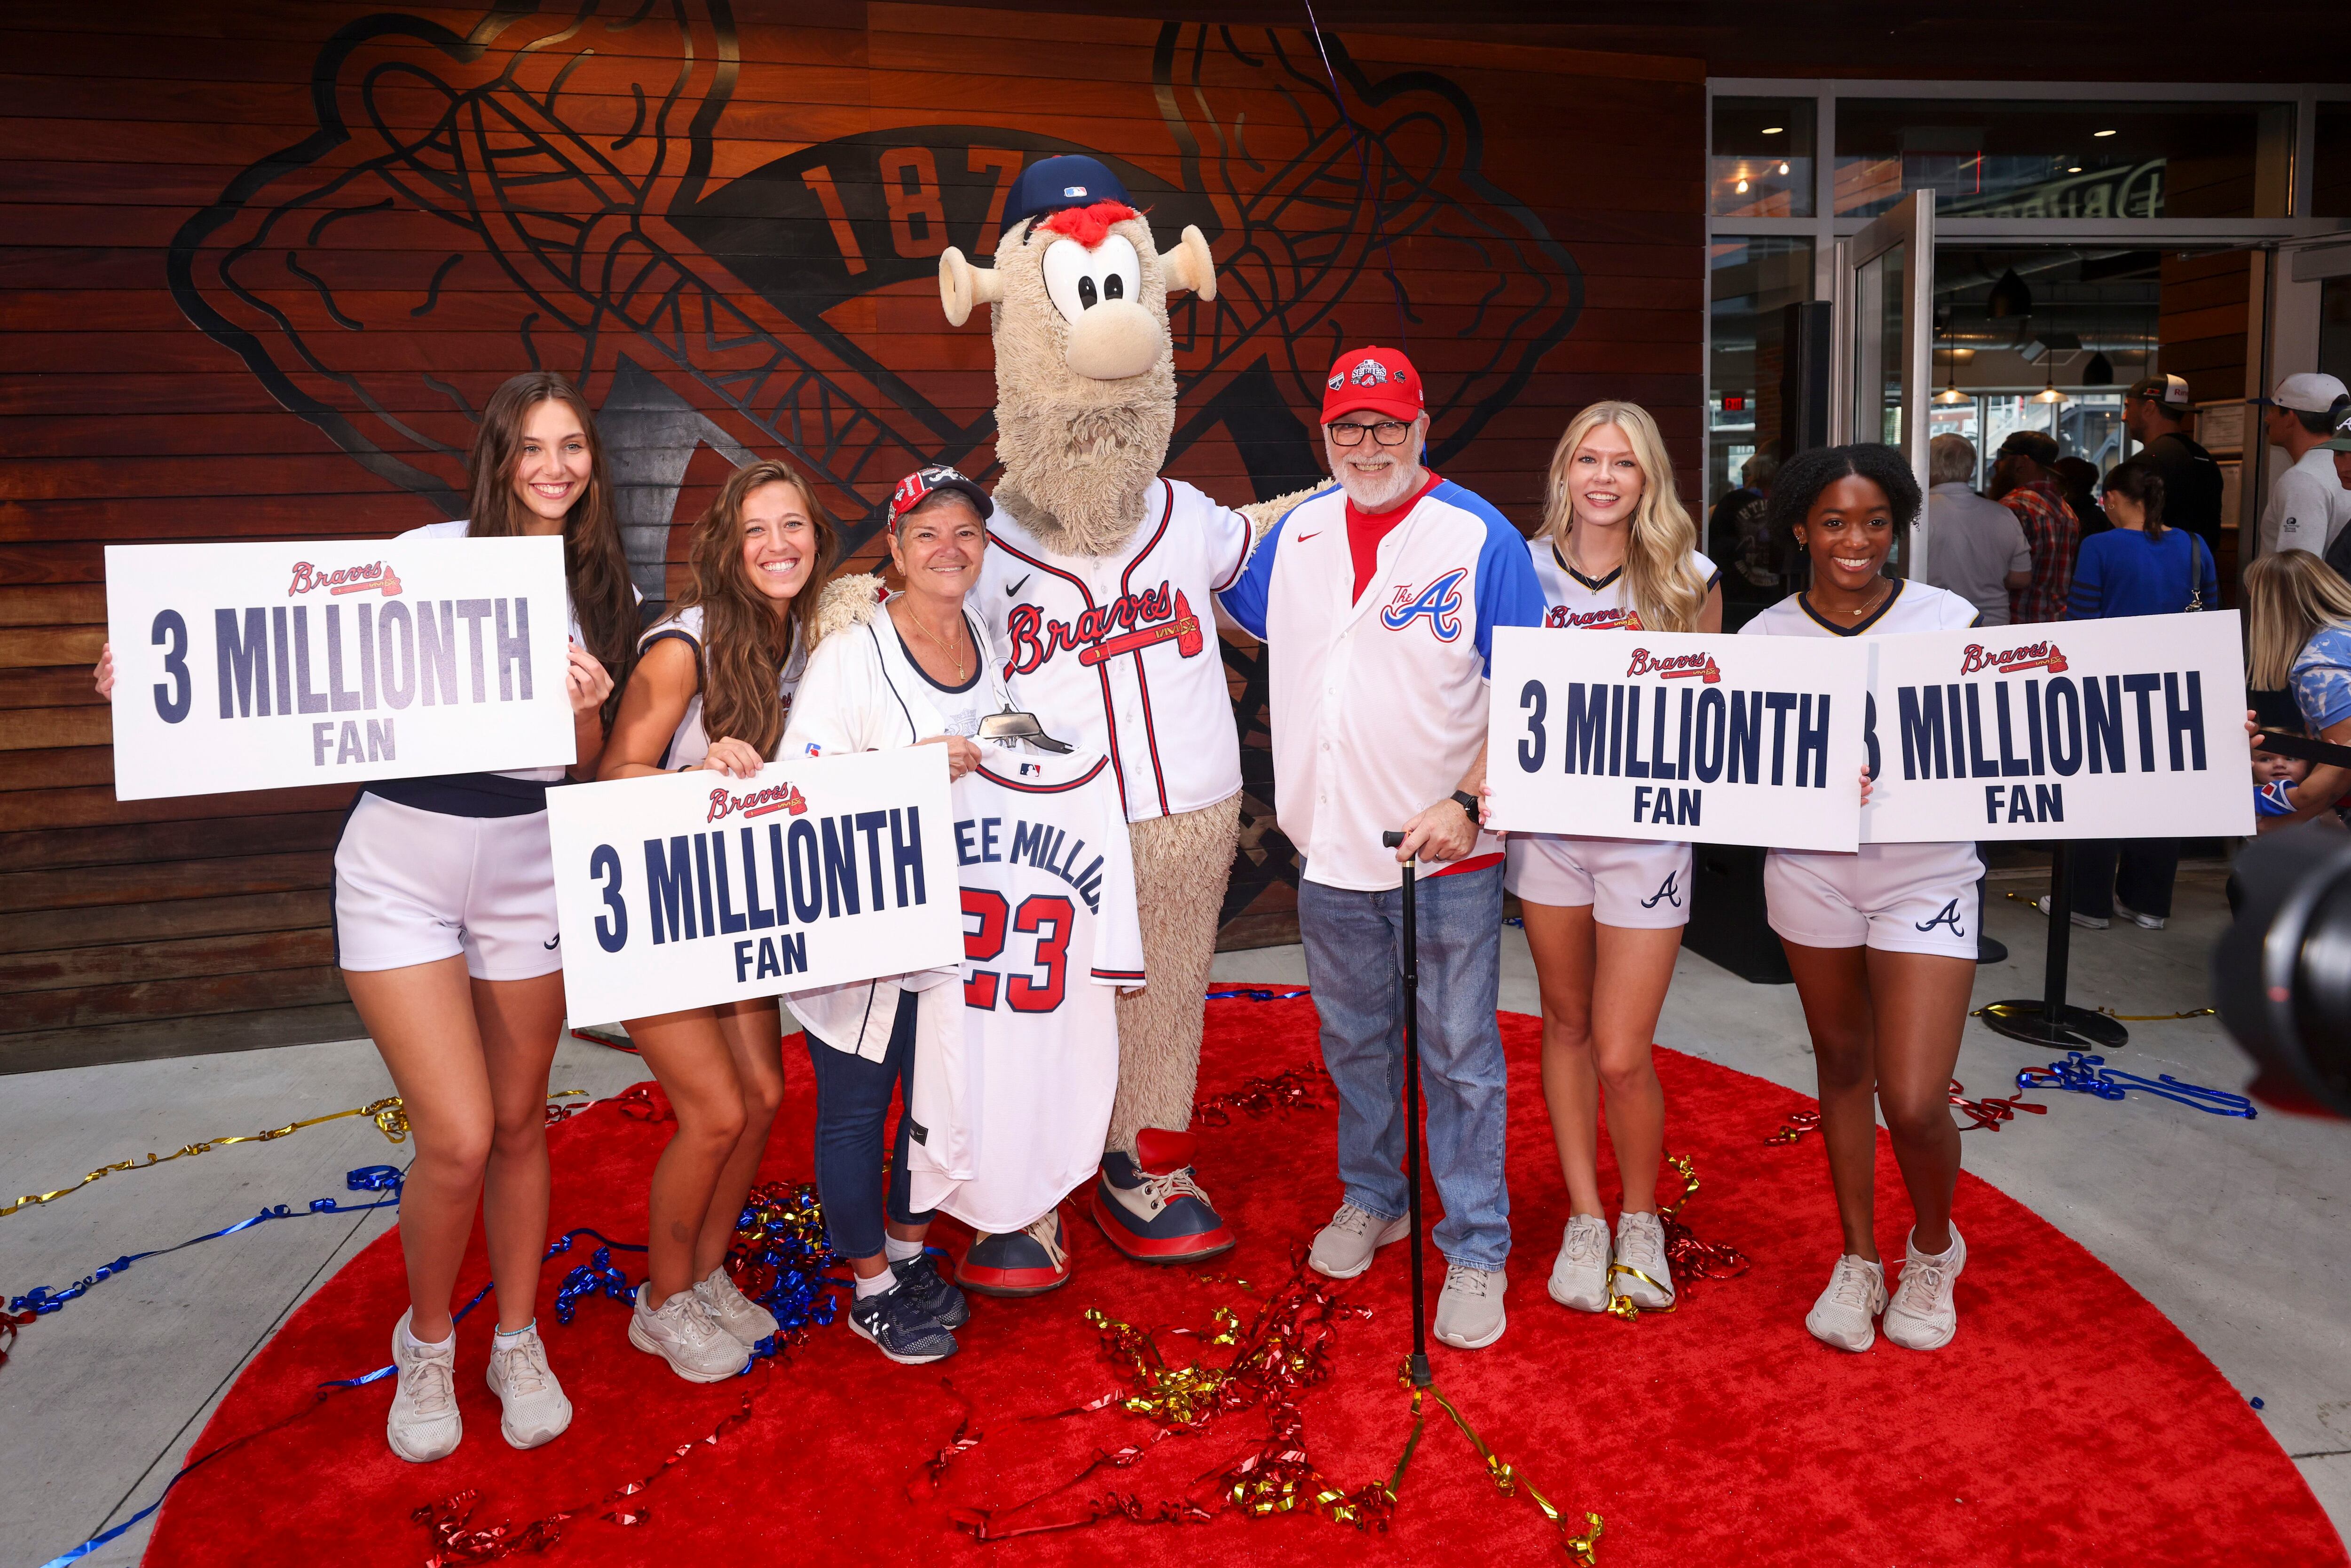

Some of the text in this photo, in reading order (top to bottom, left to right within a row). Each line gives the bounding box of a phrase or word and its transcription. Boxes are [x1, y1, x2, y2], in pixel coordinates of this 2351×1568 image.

[288, 561, 381, 597] Braves
[1392, 583, 1413, 605] The
[1380, 567, 1468, 643] A
[1003, 580, 1172, 682] Braves
[151, 597, 533, 724] 3 MILLIONTH
[1627, 648, 1705, 678] Braves
[1961, 640, 2048, 676] Braves
[313, 718, 396, 766] FAN
[1518, 679, 1830, 788] 3 MILLIONTH
[1897, 670, 2207, 781] MILLIONTH
[707, 782, 789, 823] Braves
[1633, 786, 1701, 826] FAN
[1985, 783, 2064, 824] FAN
[590, 806, 926, 953] 3 MILLIONTH
[954, 818, 1104, 915] EE MILLIO
[1641, 870, 1681, 908] A
[1916, 898, 1964, 937] A
[734, 932, 808, 983] FAN
[959, 886, 1075, 1013] 23
